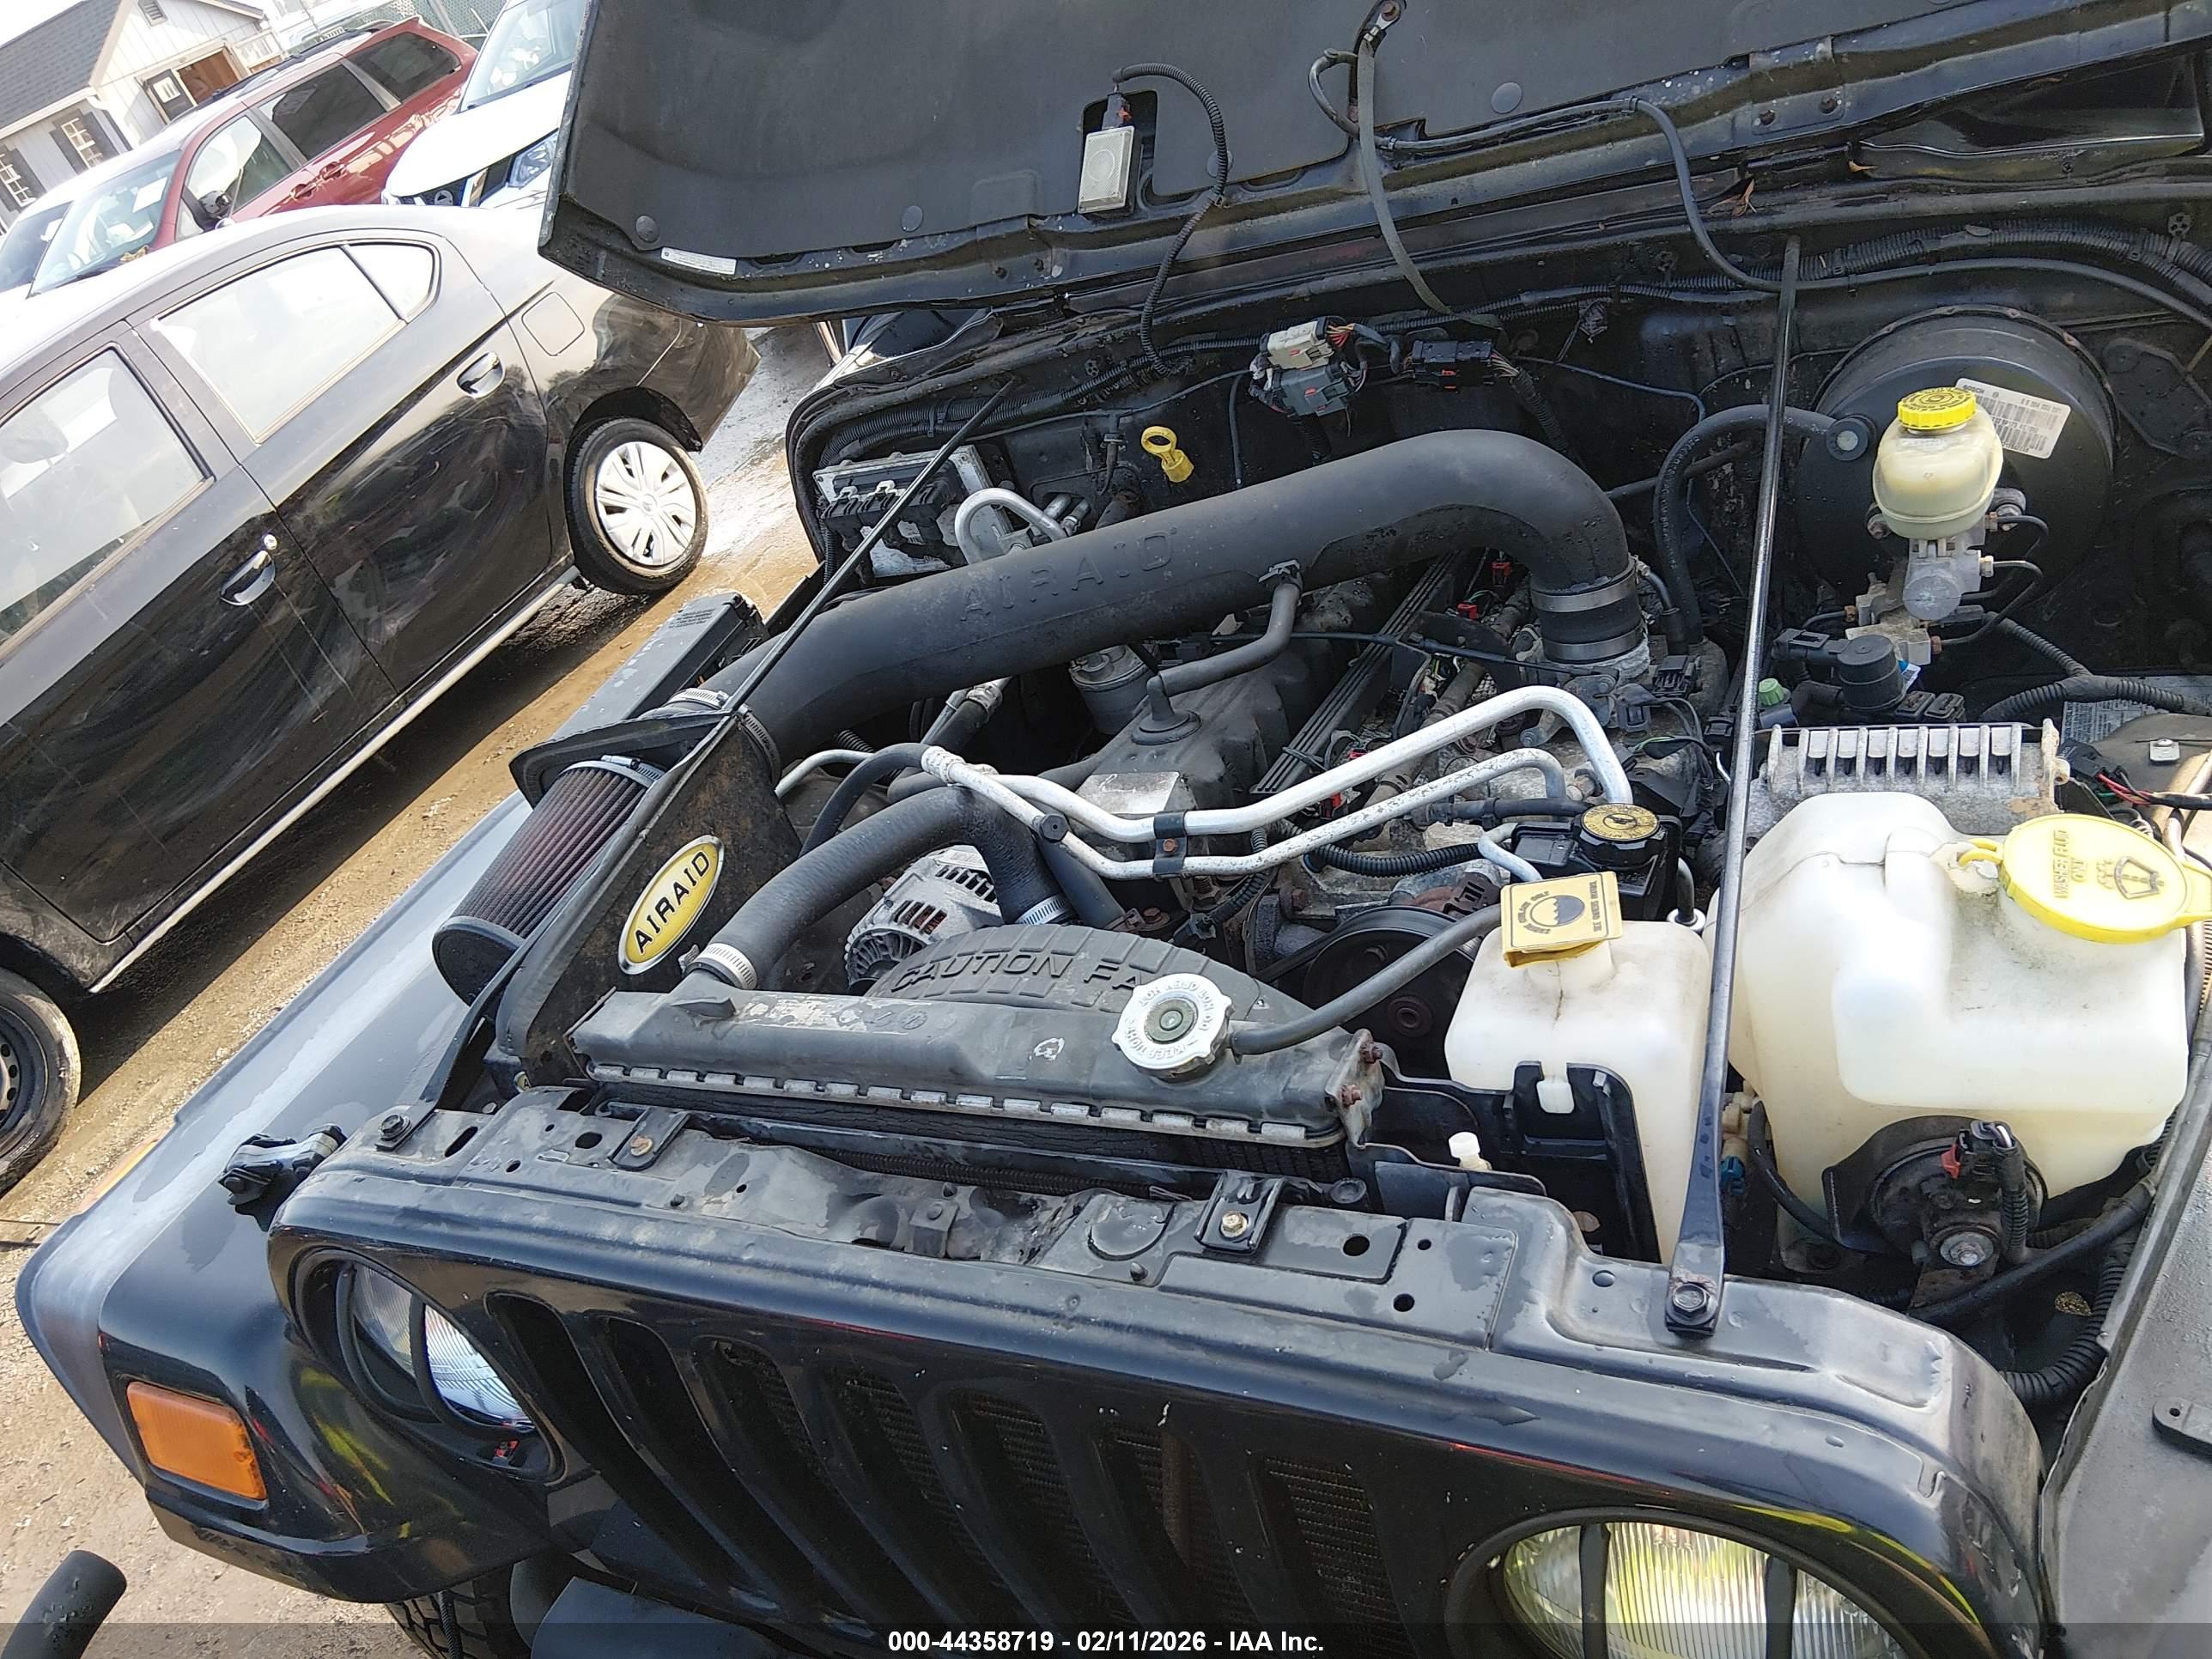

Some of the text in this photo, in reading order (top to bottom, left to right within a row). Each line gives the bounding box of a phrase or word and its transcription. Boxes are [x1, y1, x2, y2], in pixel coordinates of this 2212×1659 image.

[635, 851, 710, 954] AIRAID
[890, 952, 1143, 994] CAUTION FA
[1146, 1042, 1188, 1060] KEEP
